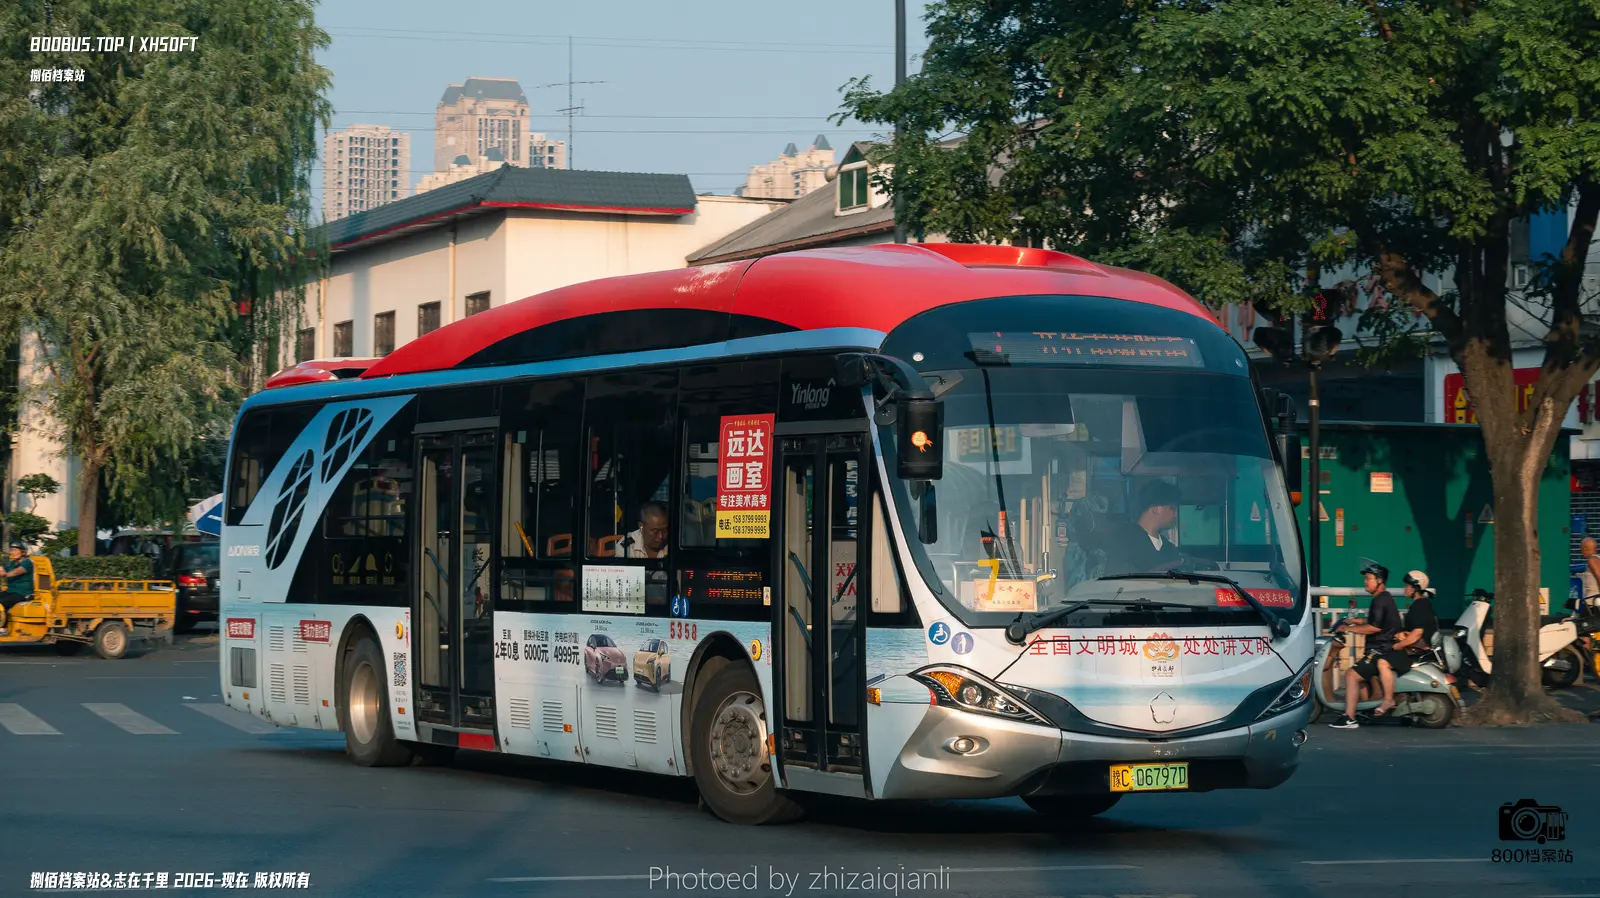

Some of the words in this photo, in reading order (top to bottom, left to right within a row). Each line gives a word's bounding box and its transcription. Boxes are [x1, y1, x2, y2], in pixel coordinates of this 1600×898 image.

[791, 382, 830, 407] Yinlong
[726, 429, 765, 457] 远达
[725, 461, 763, 488] 画室
[720, 494, 767, 507] 专注美术高考
[977, 559, 999, 600] 7
[670, 621, 698, 641] 5358
[524, 643, 550, 663] 6000元
[553, 645, 580, 665] 4999元
[1028, 634, 1139, 656] 全国文明城
[1183, 635, 1271, 656] 处处讲文明
